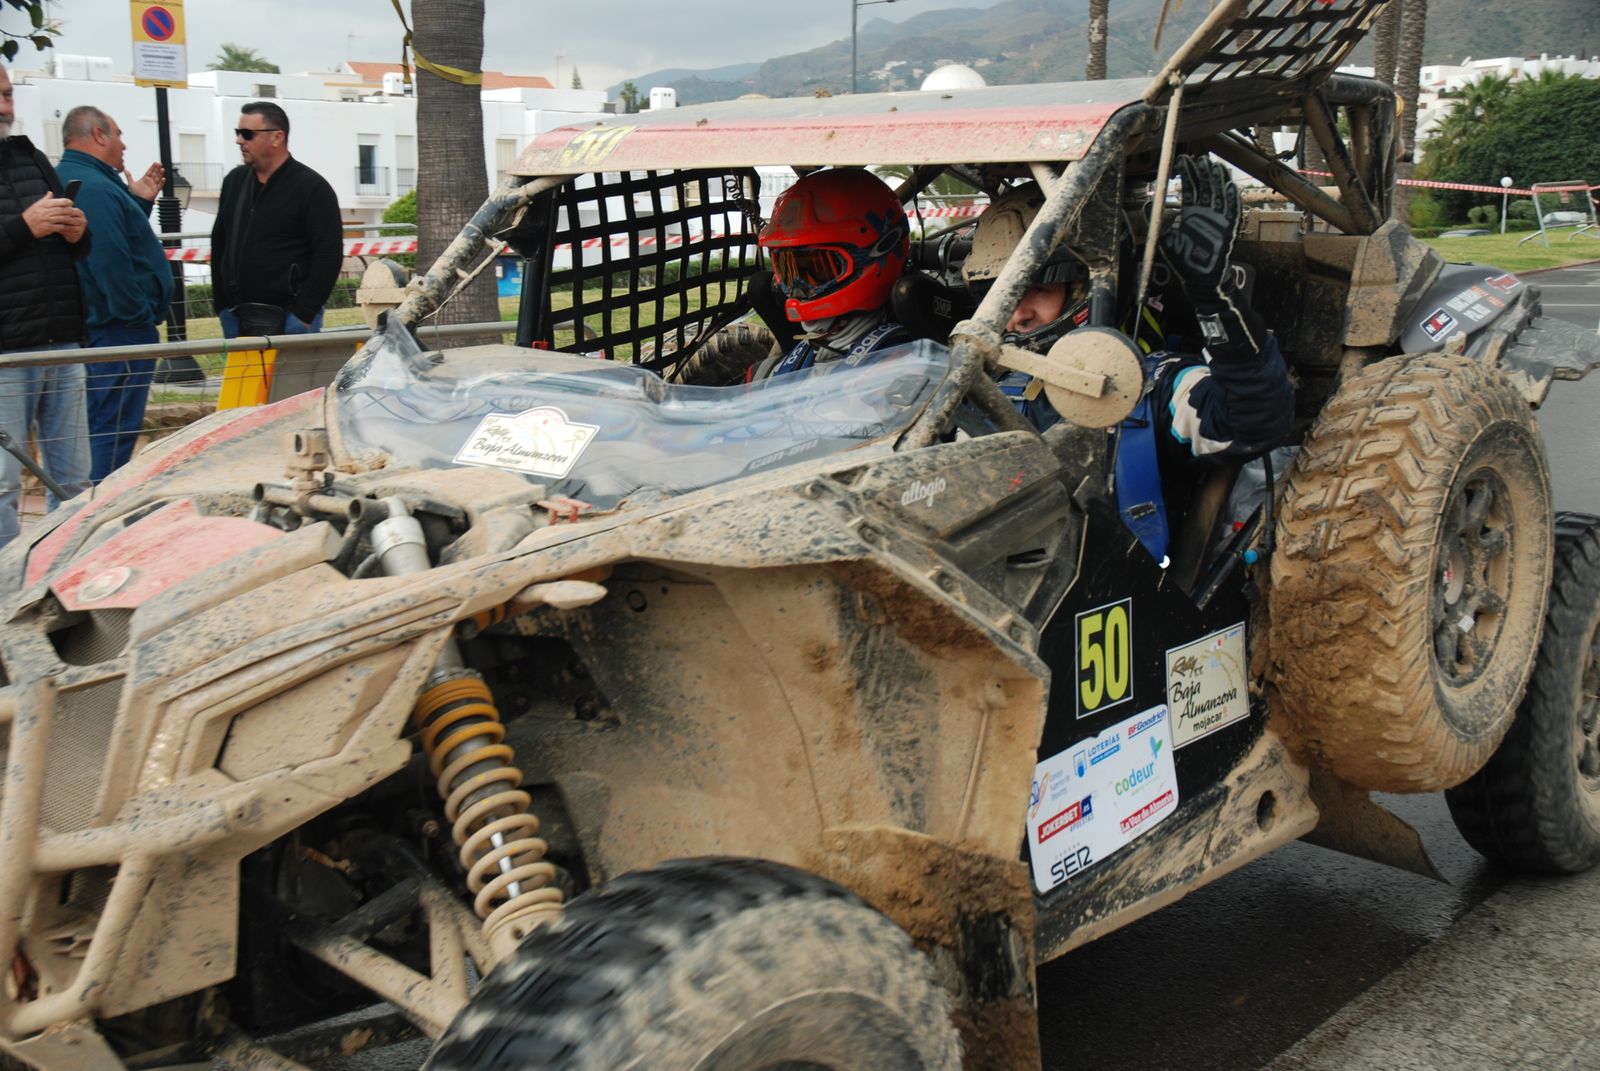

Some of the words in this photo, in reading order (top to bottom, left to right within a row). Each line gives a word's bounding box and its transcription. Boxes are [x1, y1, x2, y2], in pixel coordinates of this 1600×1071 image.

[560, 125, 636, 167] 50
[472, 437, 502, 457] Baja
[1081, 606, 1129, 710] 50
[1169, 681, 1201, 704] Baja
[1179, 687, 1237, 729] Almanzora
[1128, 709, 1168, 736] BFGoodrich
[1087, 733, 1121, 758] LOTERÍAS
[1115, 761, 1155, 796] codeur
[1051, 846, 1094, 884] SER
